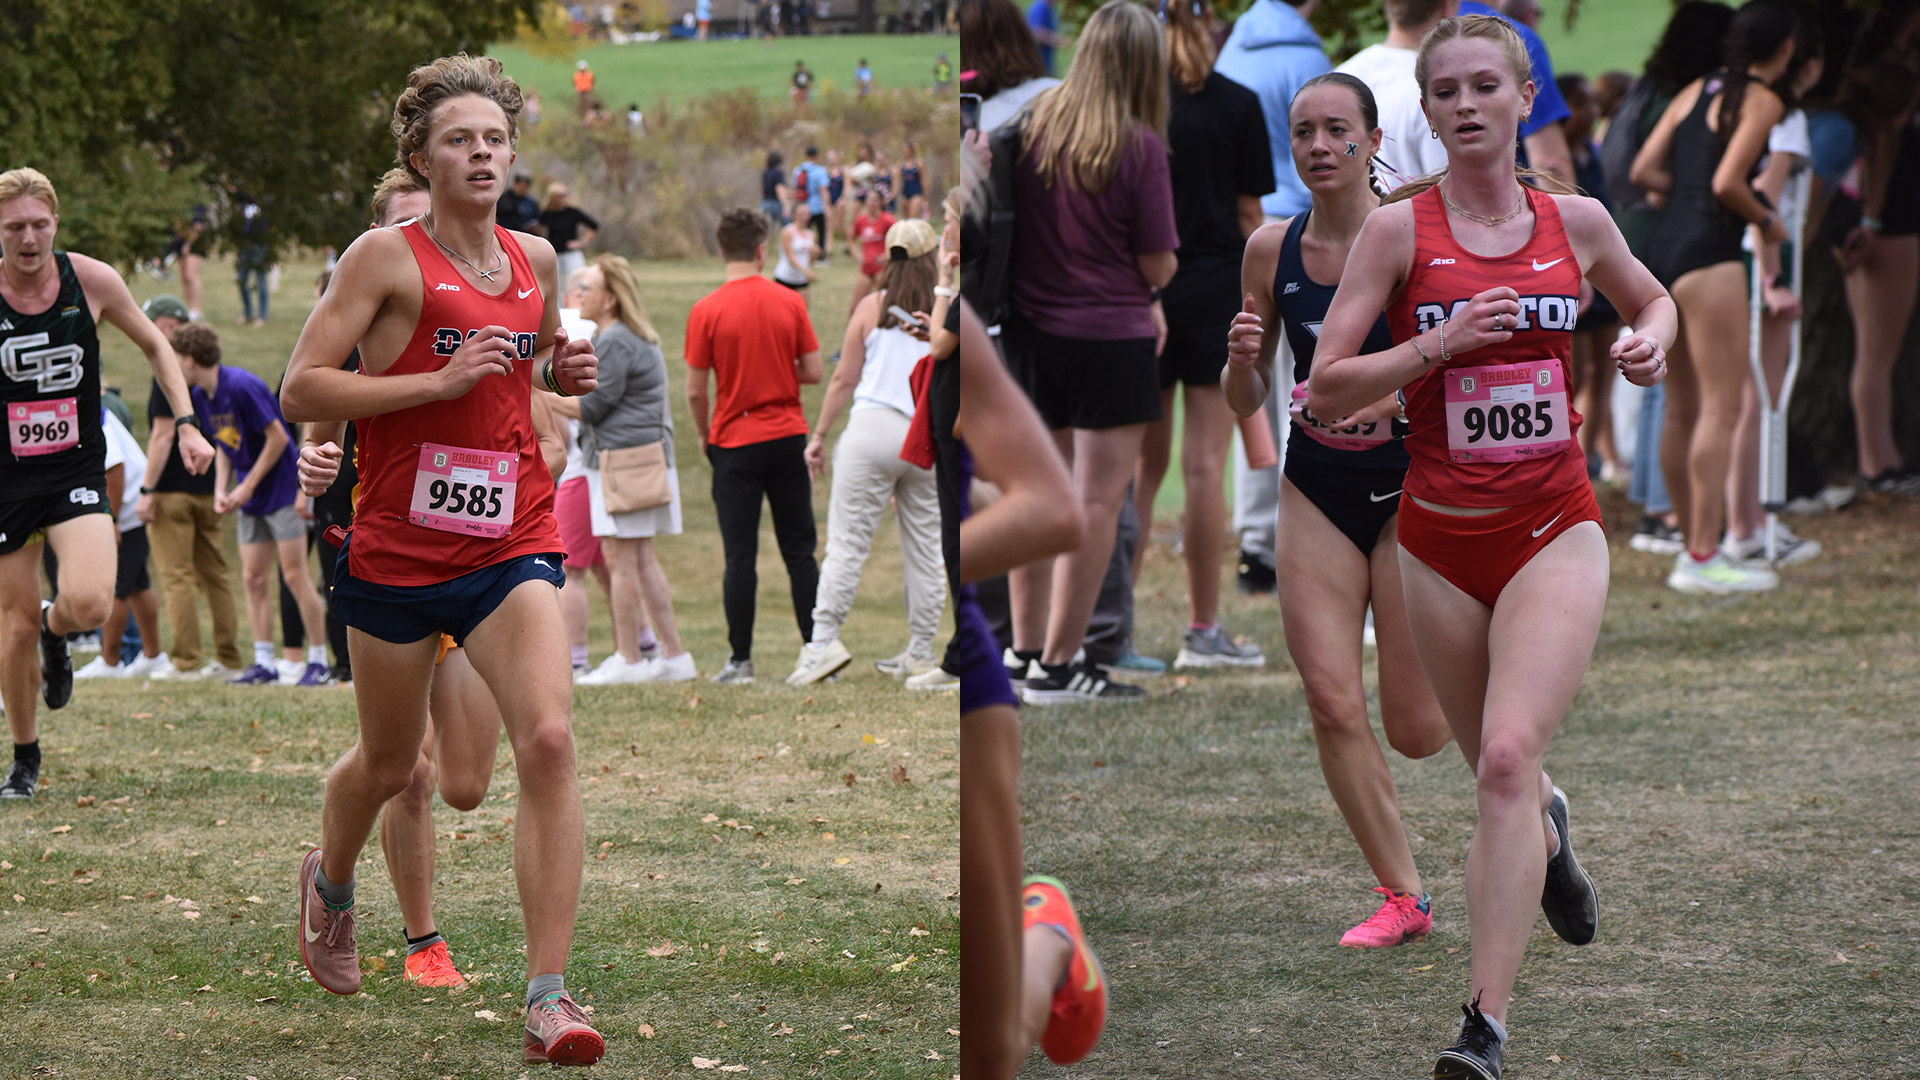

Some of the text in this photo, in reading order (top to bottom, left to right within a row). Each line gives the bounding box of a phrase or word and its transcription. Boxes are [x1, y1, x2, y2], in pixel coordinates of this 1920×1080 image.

[1344, 141, 1359, 157] X
[1480, 367, 1531, 383] BRADLEY
[1463, 400, 1553, 443] 9085
[19, 420, 69, 444] 9969
[451, 452, 496, 466] BRADLEY
[428, 479, 503, 518] 9585
